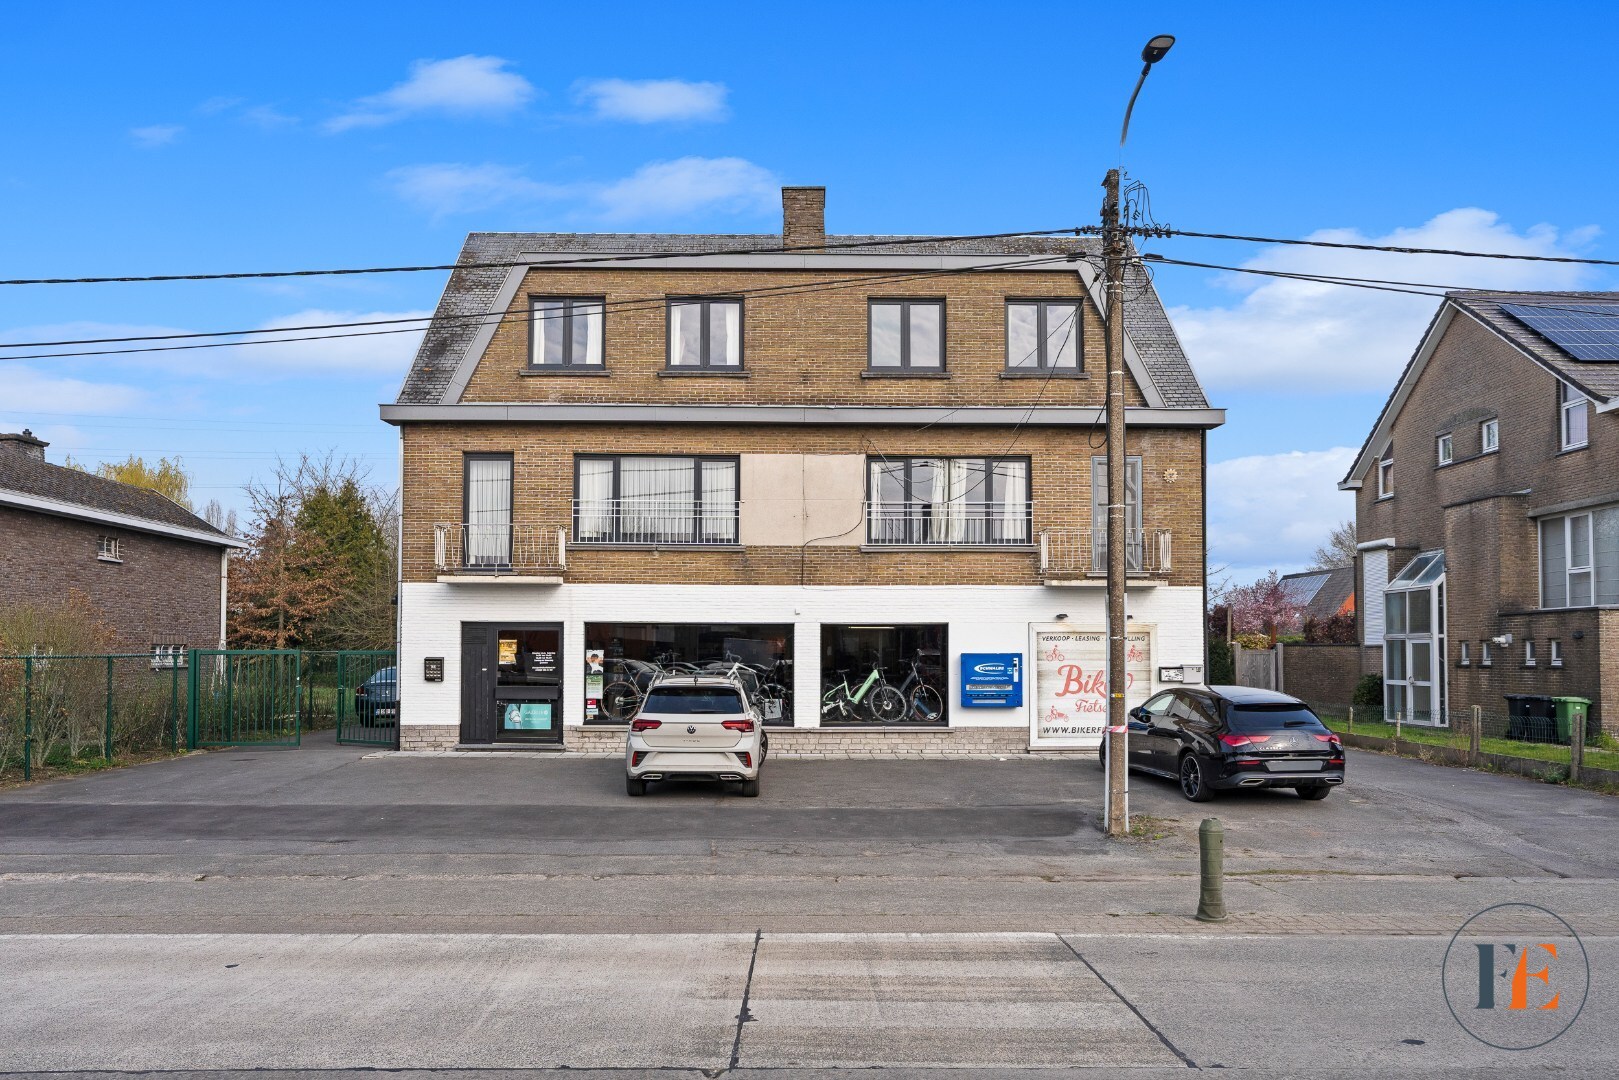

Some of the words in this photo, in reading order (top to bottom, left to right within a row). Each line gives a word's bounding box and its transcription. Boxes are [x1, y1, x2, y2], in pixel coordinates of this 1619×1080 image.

[1055, 664, 1134, 699] Bik
[1075, 699, 1107, 713] Fiets
[1042, 726, 1106, 734] WWW.BIKERF
